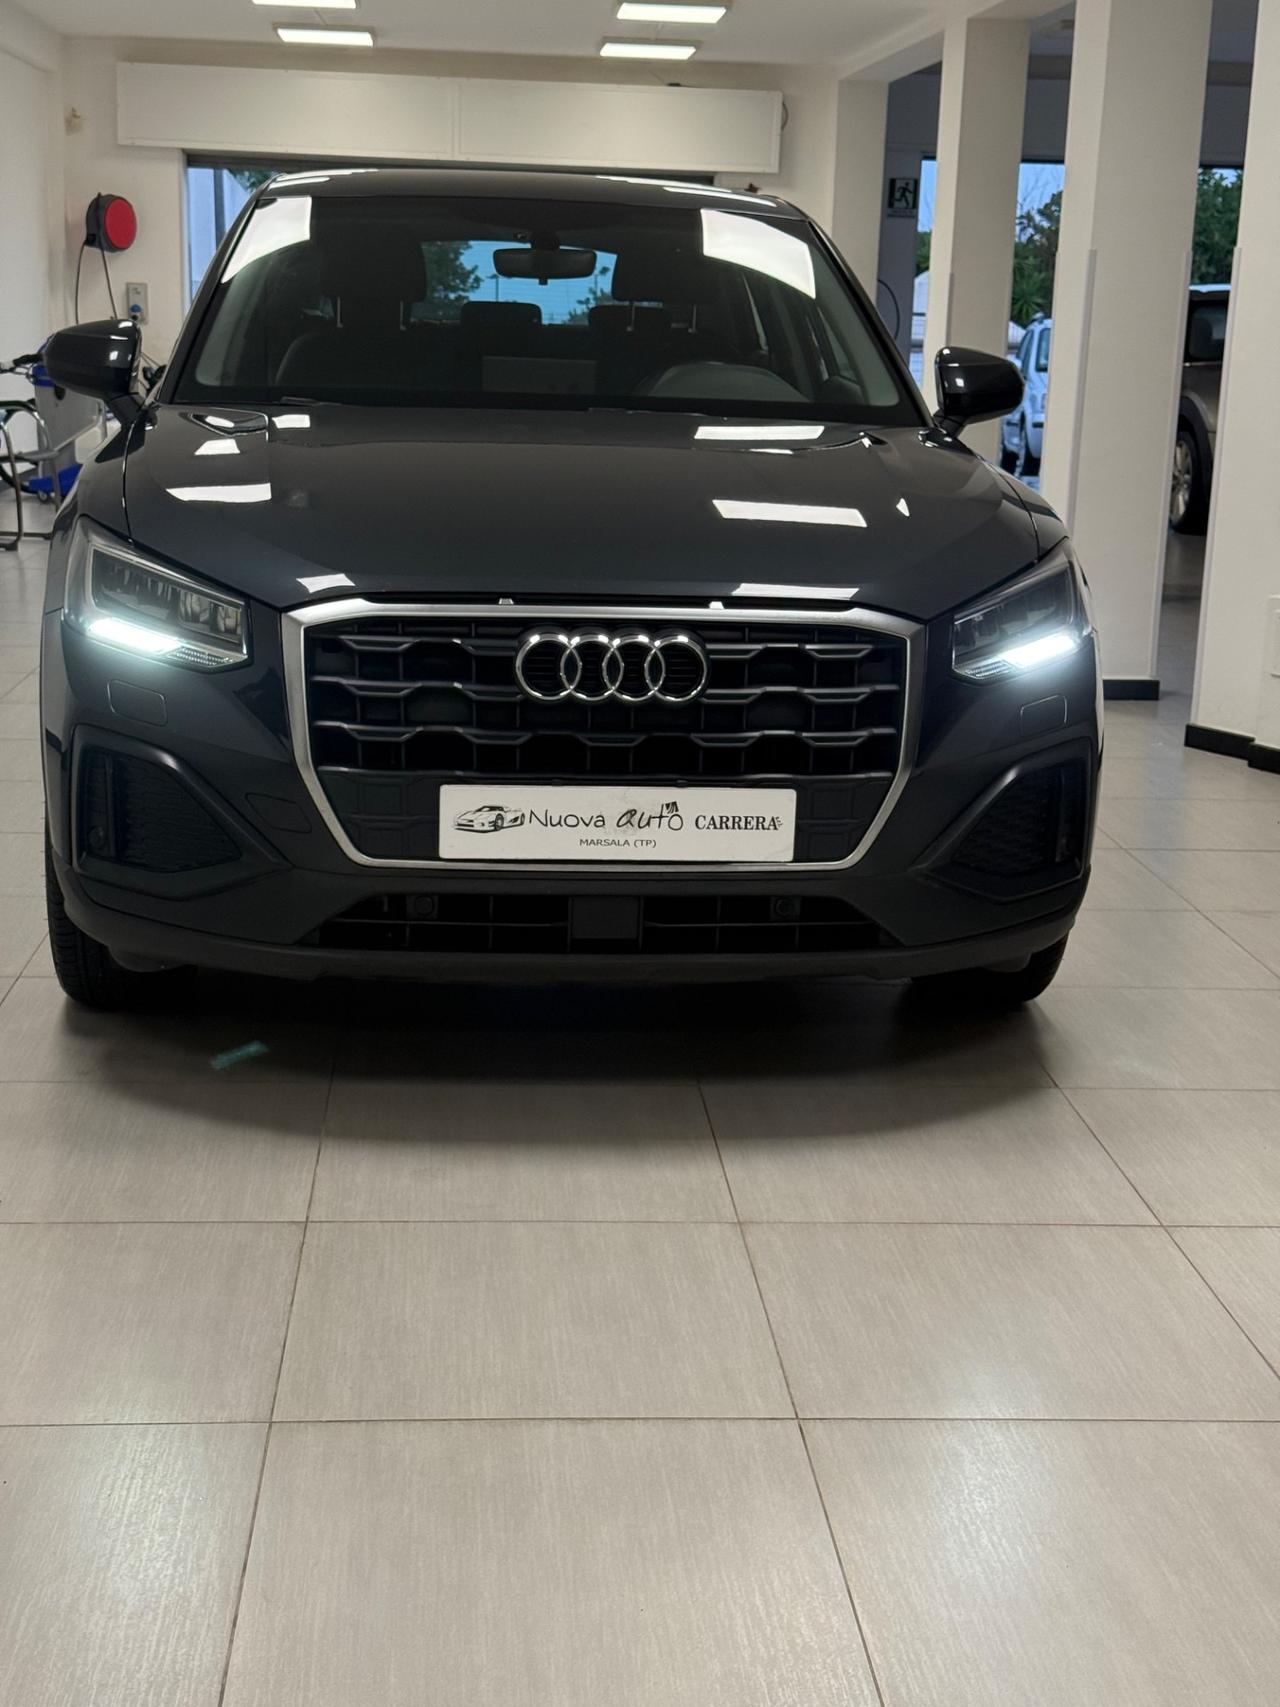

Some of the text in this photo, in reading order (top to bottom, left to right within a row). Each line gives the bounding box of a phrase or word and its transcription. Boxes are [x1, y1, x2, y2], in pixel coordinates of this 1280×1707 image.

[529, 809, 605, 828] Nuova
[695, 815, 778, 830] CARRERA
[579, 838, 657, 848] MARSALA (TP)
